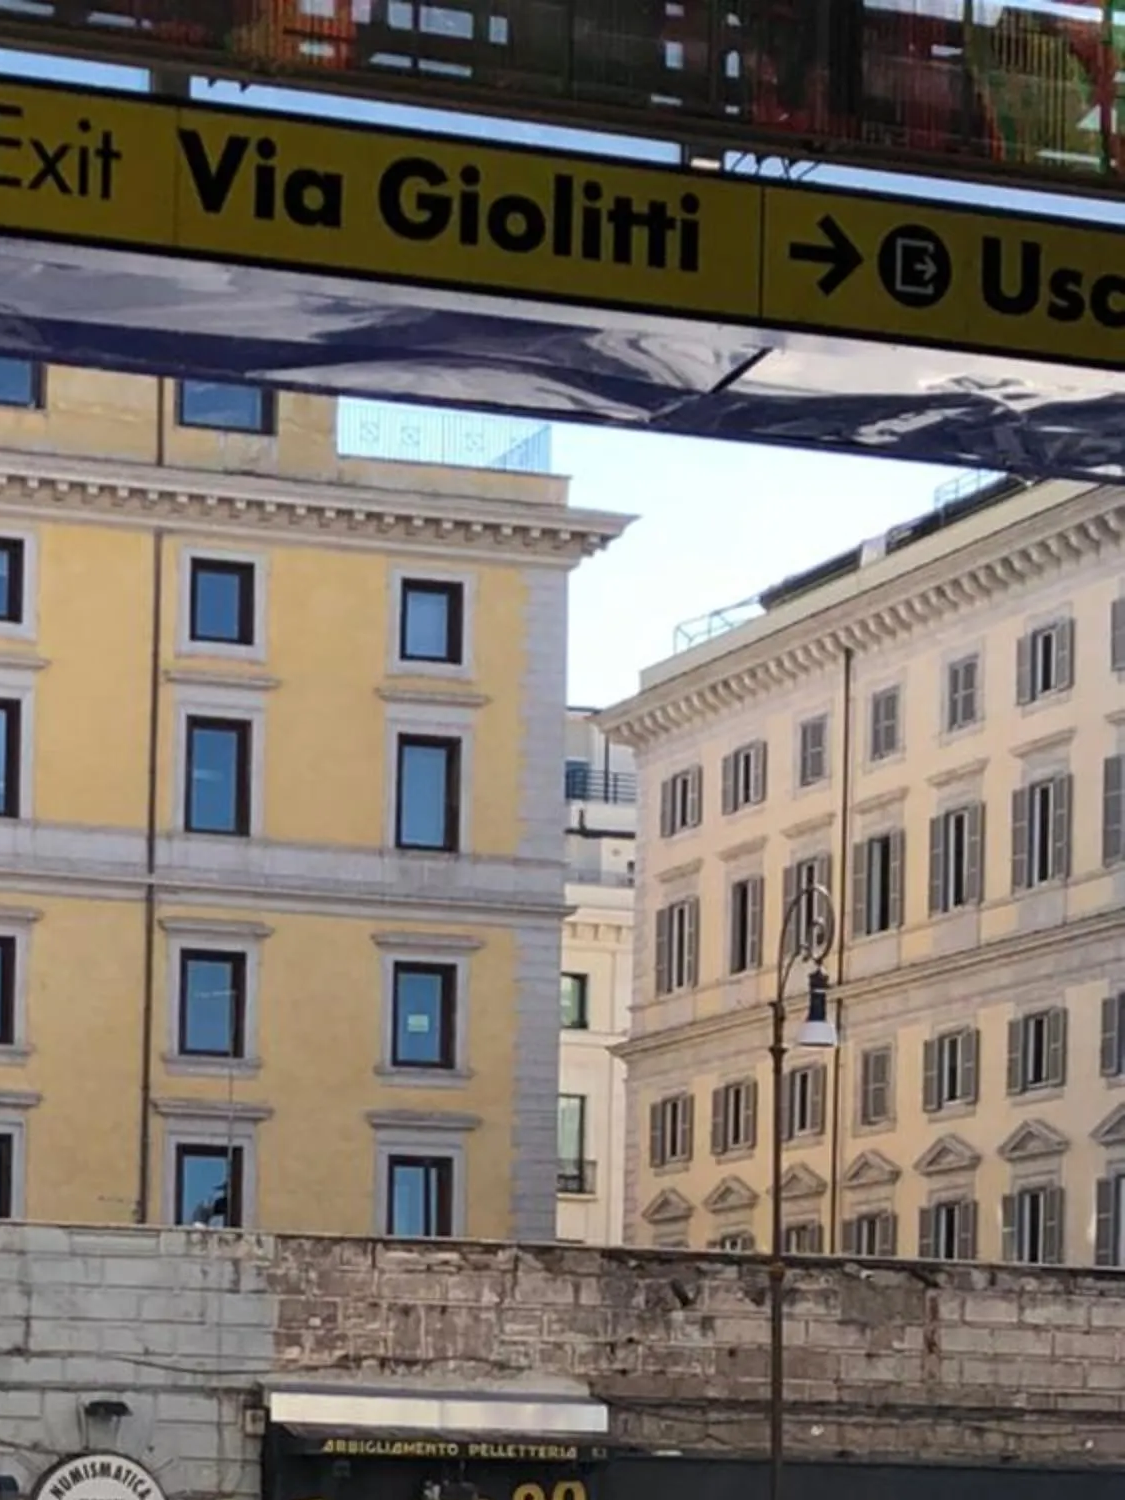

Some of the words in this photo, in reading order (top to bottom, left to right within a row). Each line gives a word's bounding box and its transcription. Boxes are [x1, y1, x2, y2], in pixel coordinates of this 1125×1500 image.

[178, 127, 344, 229] Via
[378, 156, 701, 273] Giolitti
[982, 235, 1125, 329] Usc
[49, 1461, 153, 1500] NUMISMATICA
